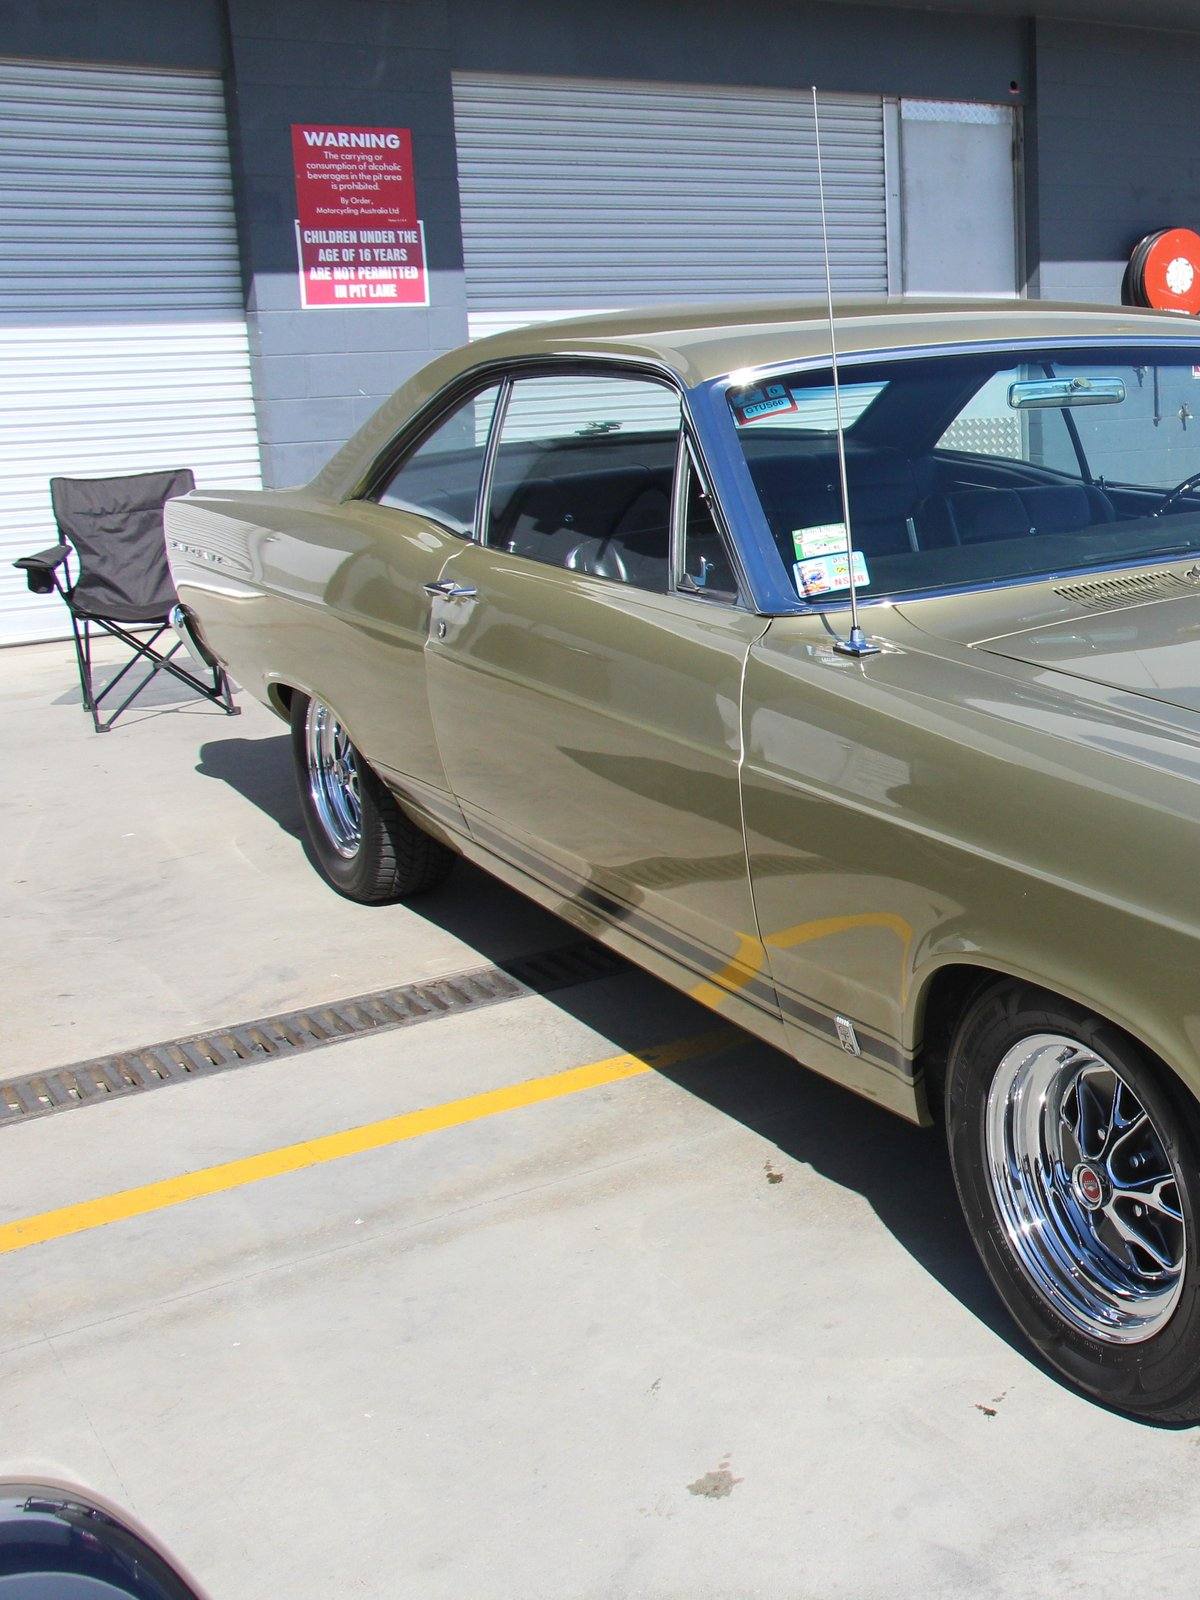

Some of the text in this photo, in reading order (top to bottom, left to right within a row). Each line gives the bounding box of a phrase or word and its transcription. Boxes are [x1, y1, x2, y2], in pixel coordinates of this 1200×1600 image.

[303, 130, 401, 149] WARNING
[323, 151, 339, 160] The
[340, 152, 373, 162] carrying
[306, 162, 402, 171] consumption of alcoholic
[306, 171, 350, 182] beverages
[350, 172, 358, 180] in
[358, 172, 372, 180] the
[373, 173, 382, 182] pit
[331, 182, 338, 190] is
[340, 197, 349, 205] By
[316, 207, 359, 216] Motorcycling
[303, 230, 418, 243] CHILDREN UNDER THE
[318, 248, 408, 262] AGE OF 16 YEARS
[309, 266, 419, 280] ARE NOT PERMITTED
[334, 283, 398, 298] IN PIT LANE
[745, 399, 785, 414] GTUS66
